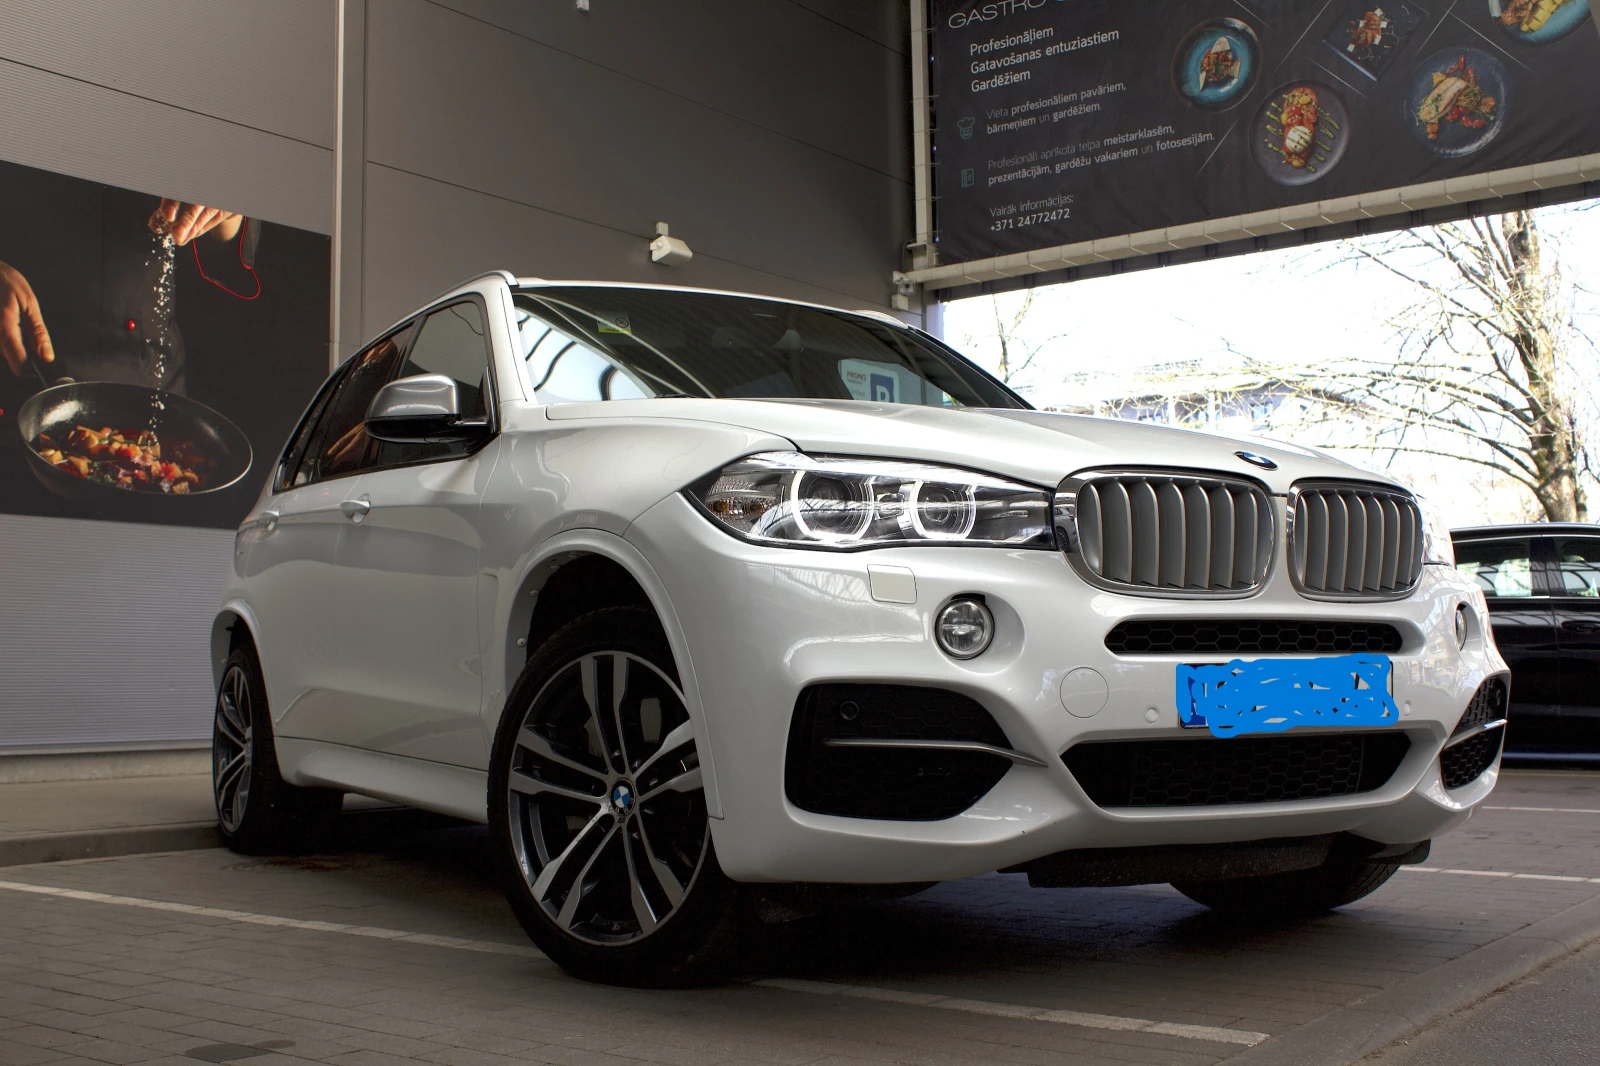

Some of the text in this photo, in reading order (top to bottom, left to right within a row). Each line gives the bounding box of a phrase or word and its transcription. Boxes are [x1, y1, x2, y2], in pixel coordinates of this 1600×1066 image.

[970, 27, 1054, 56] Profesionāļiem
[971, 30, 1120, 74] Gatavošanas entuziastiem
[971, 70, 1031, 92] Gardēžiem
[986, 108, 1009, 120] Vieta
[1080, 82, 1127, 102] pavāriem,
[987, 116, 1036, 134] bārmeņiem
[1039, 113, 1050, 123] un
[988, 151, 1038, 170] Profesionāli
[1079, 140, 1101, 152] telpa
[1103, 125, 1175, 146] meistarklasēm,
[988, 132, 1215, 187] prezentācijām, gardēžu vakariem un fotosesijām.
[990, 195, 1074, 217] Vairāk informācijas:
[991, 208, 1071, 231] +371 24772472
